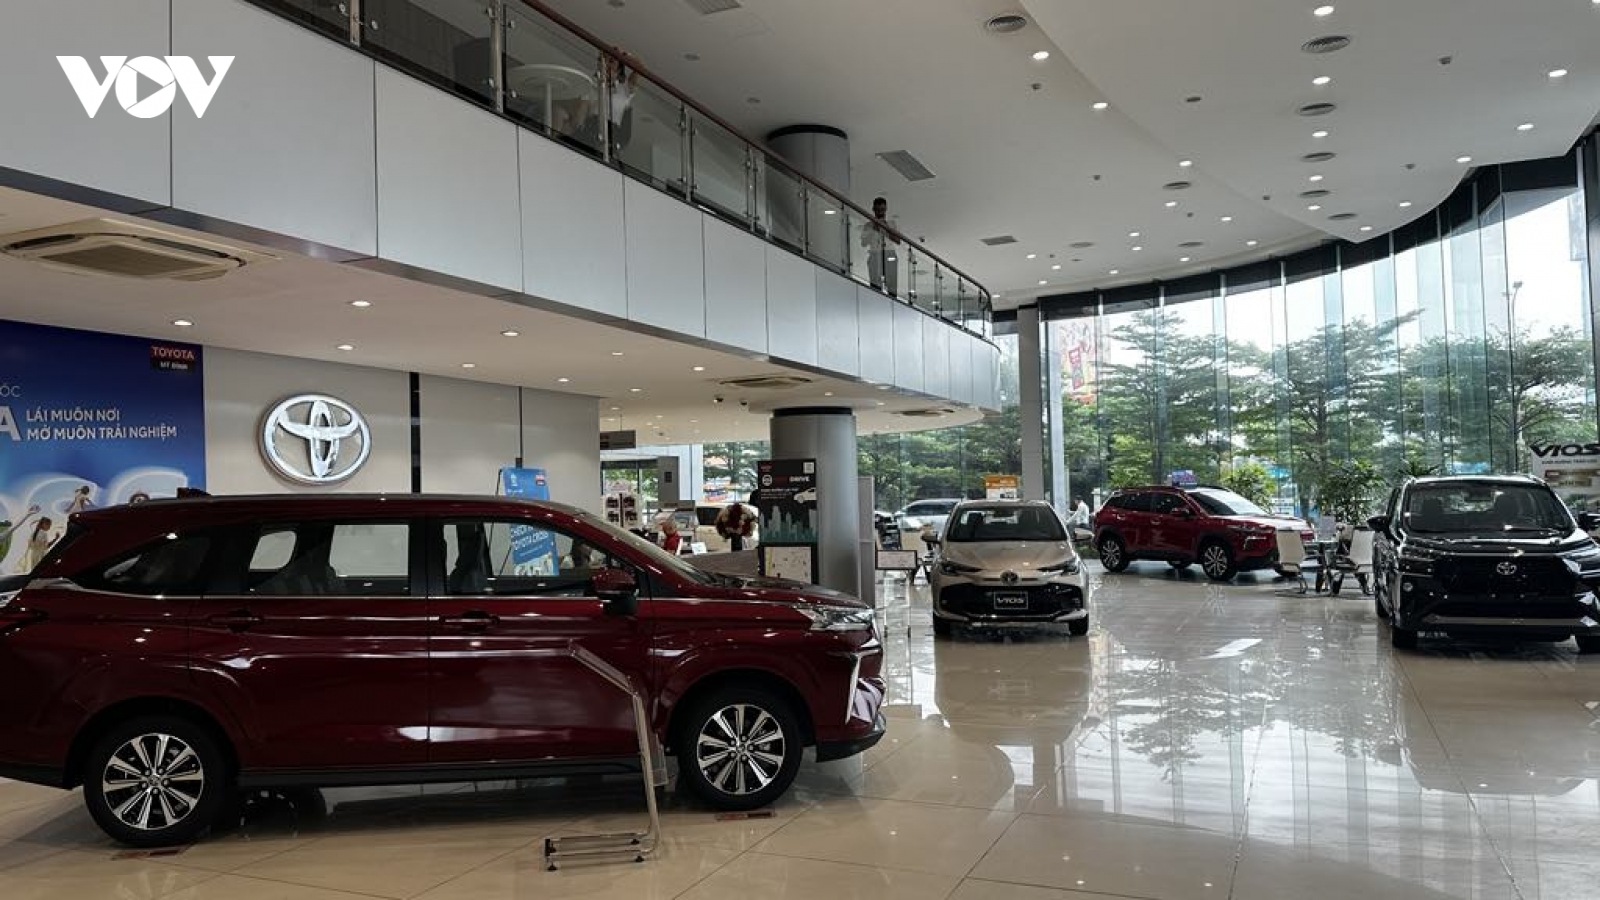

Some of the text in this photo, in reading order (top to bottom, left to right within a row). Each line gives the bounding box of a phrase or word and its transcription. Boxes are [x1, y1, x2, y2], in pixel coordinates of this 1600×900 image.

[152, 346, 195, 360] TOYOTA
[26, 405, 120, 422] LÁI MUÔN NƠI
[0, 406, 21, 441] A
[27, 422, 177, 442] MỞ MUÔN TRẢI NGHIỆM
[1530, 441, 1600, 457] VIOS
